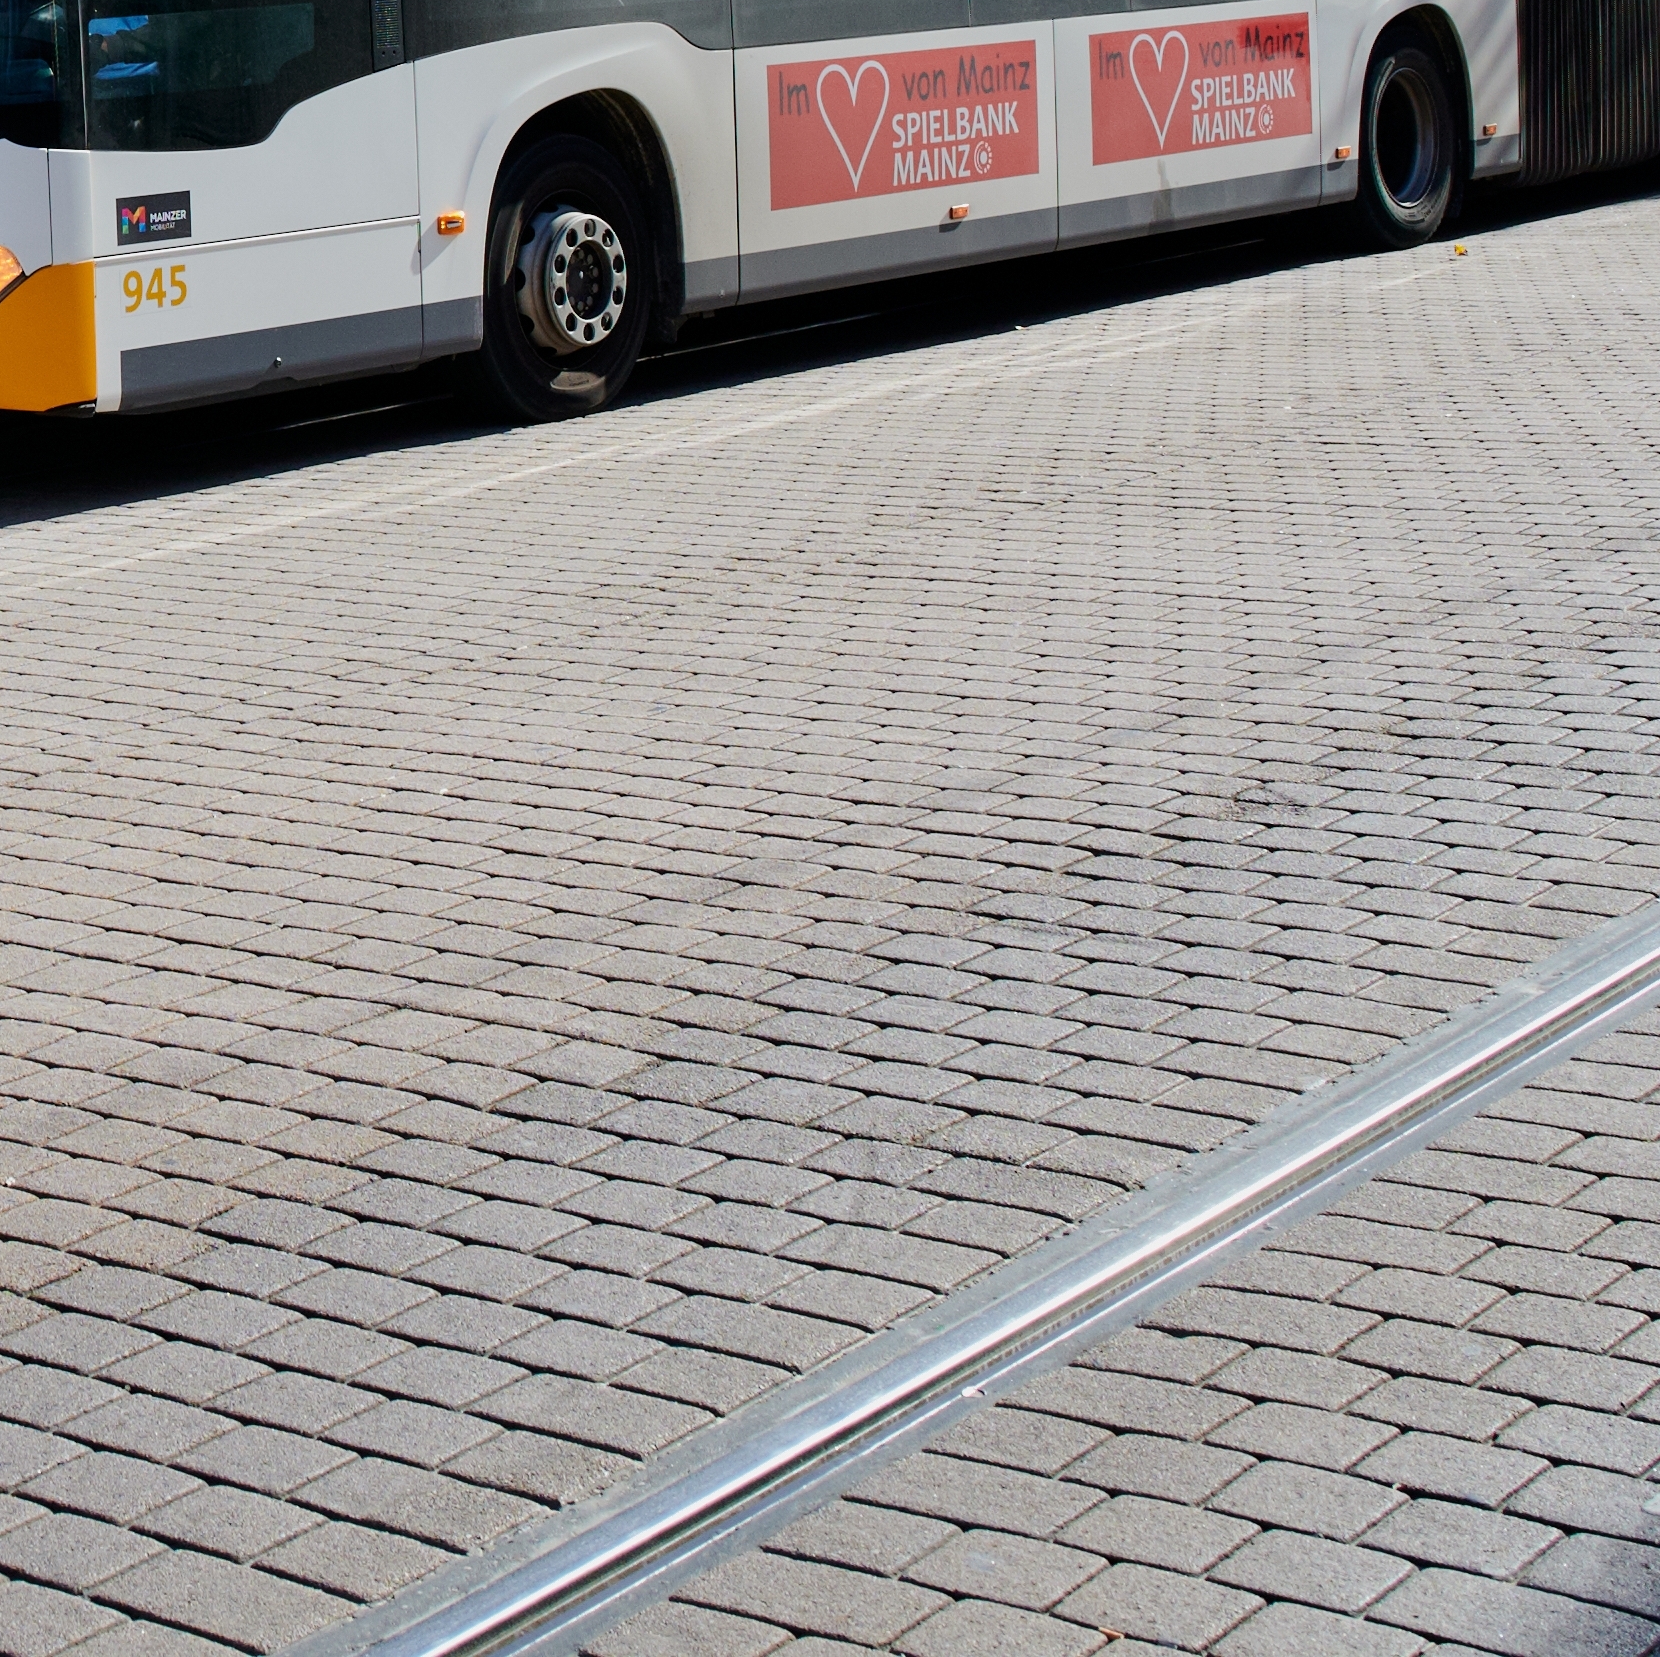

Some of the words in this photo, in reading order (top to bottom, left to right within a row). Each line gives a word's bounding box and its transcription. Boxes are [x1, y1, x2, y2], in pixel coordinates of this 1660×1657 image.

[1098, 40, 1125, 80] Im
[1199, 38, 1237, 69] von
[1244, 23, 1306, 64] Mainz
[779, 70, 810, 116] Im
[901, 67, 947, 102] von
[956, 52, 1031, 98] Mainz
[1190, 67, 1296, 111] SPIELBANK
[891, 100, 1020, 149] SPIELBANK
[1192, 107, 1257, 146] MAINZ
[892, 144, 972, 187] MAINZ
[149, 209, 187, 224] MAINZER
[123, 264, 188, 314] 945
